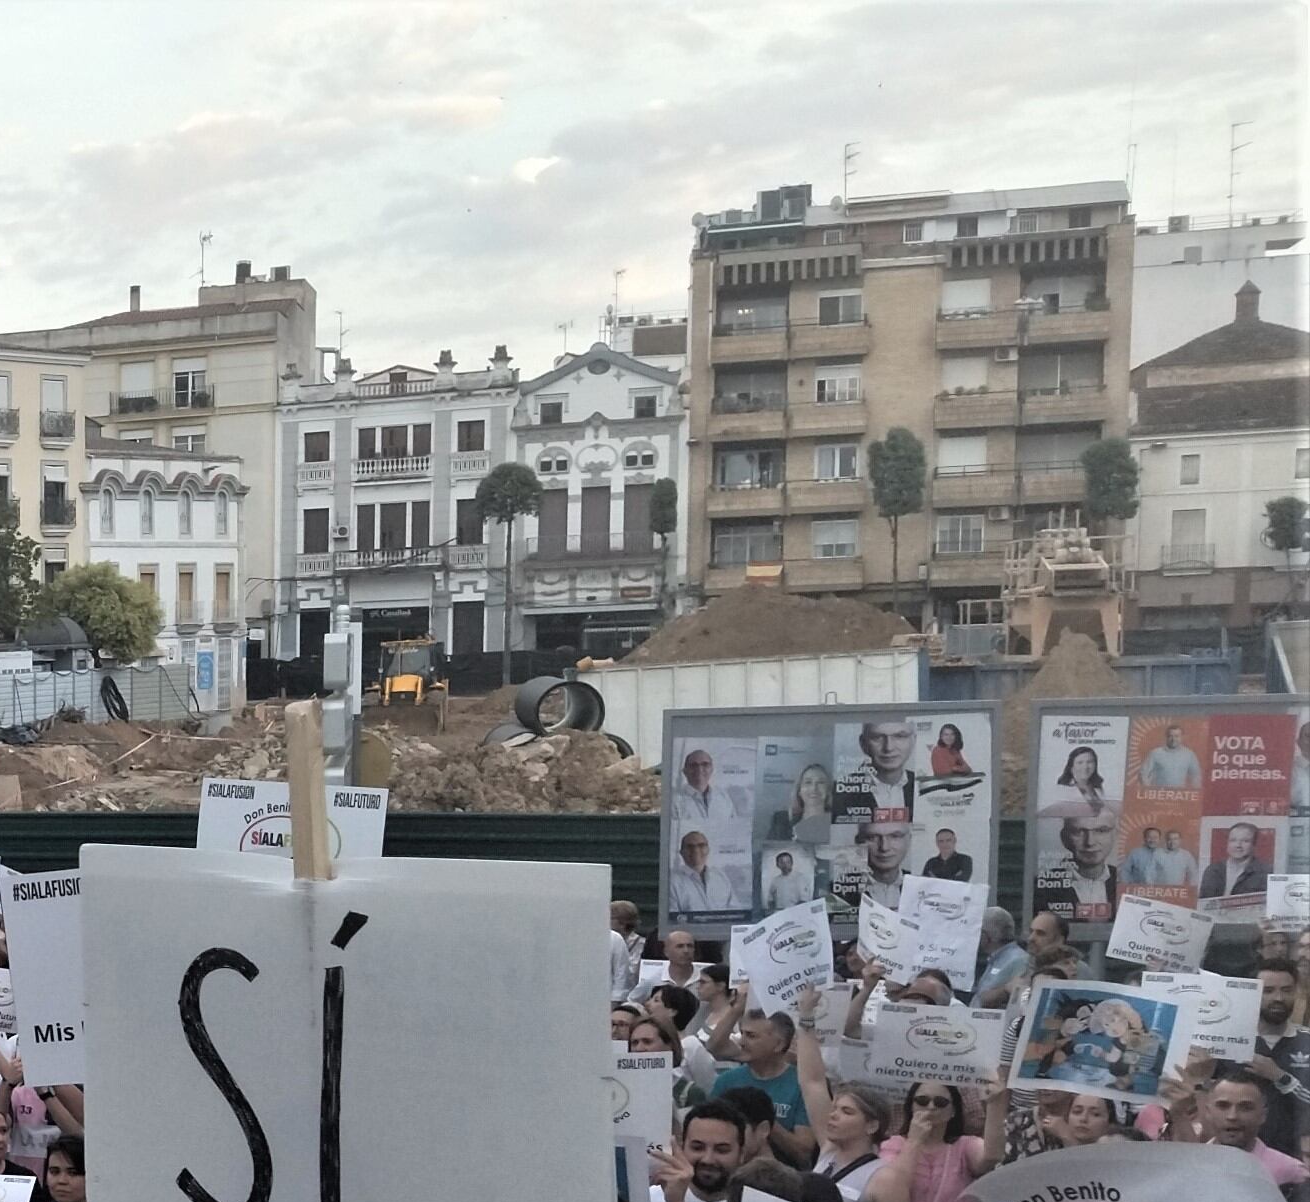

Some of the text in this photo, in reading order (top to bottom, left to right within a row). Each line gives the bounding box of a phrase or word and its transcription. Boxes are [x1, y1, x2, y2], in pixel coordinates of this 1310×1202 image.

[1214, 736, 1265, 750] VOTA
[1212, 751, 1266, 767] lo que
[1211, 767, 1286, 781] piensas.
[847, 807, 871, 815] VOTA
[34, 1022, 74, 1043] Mis
